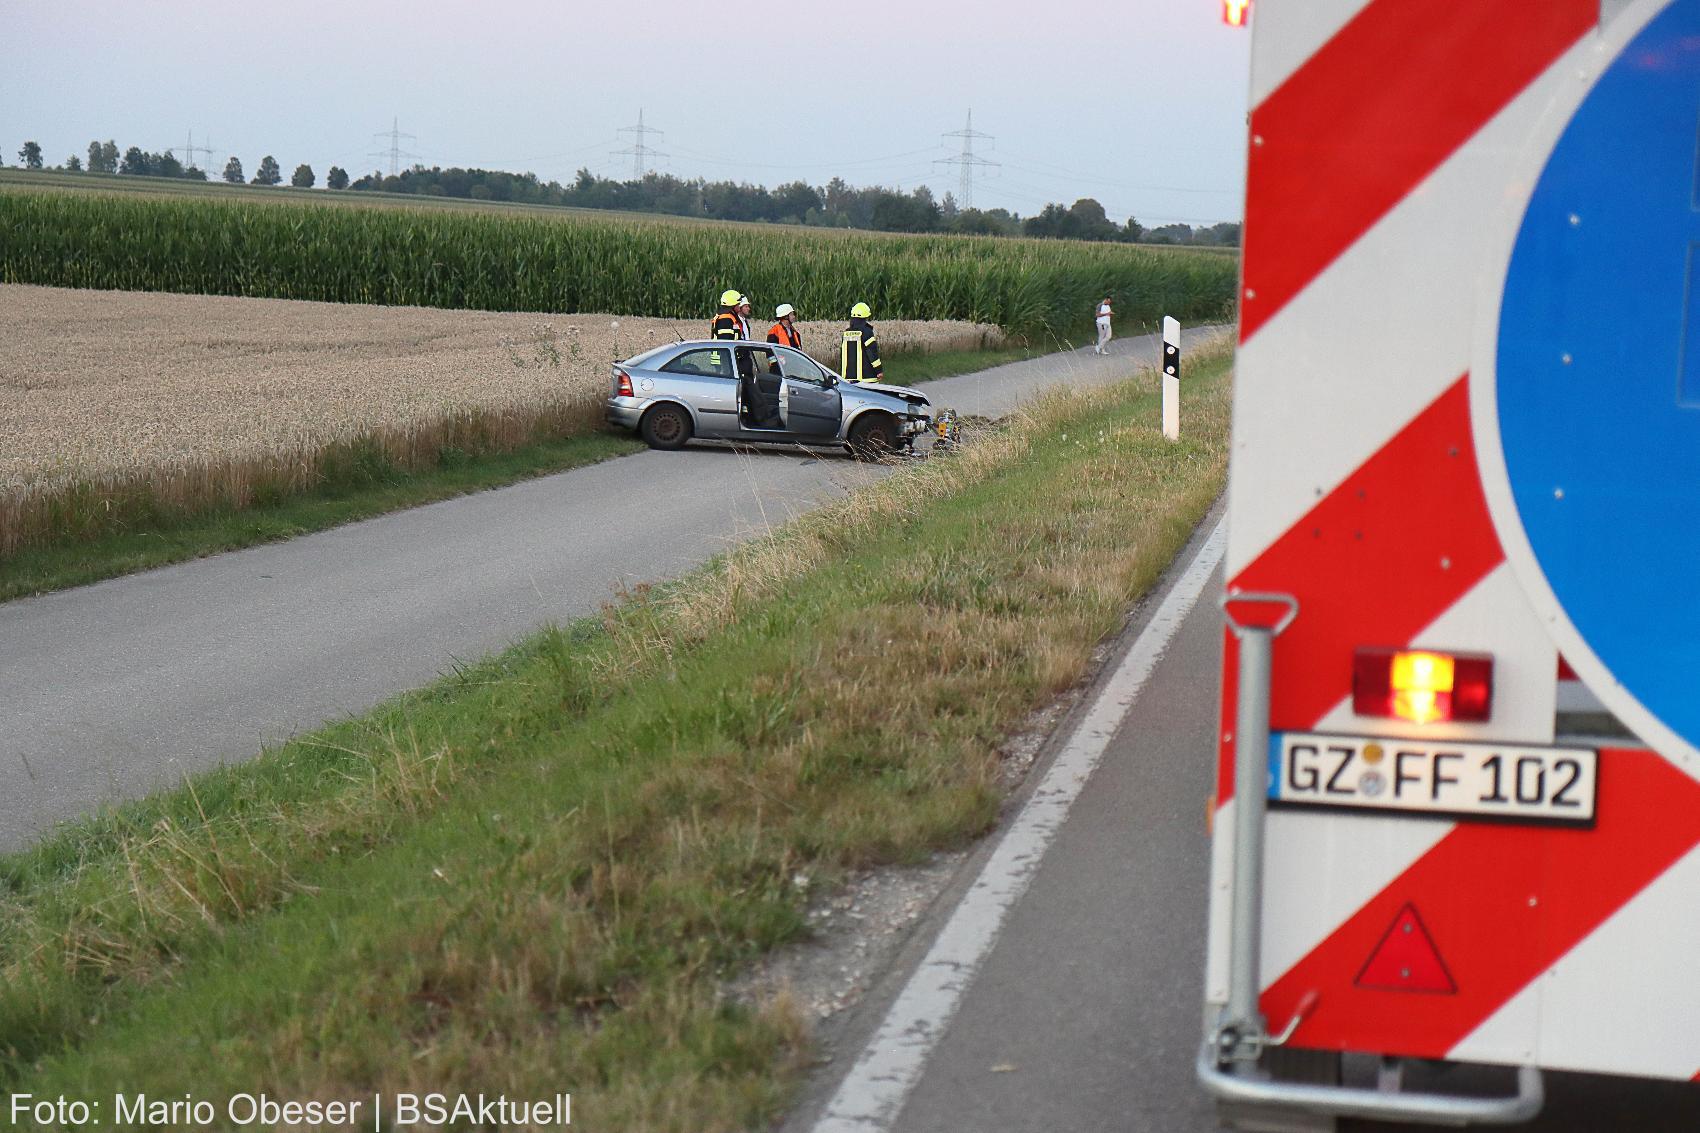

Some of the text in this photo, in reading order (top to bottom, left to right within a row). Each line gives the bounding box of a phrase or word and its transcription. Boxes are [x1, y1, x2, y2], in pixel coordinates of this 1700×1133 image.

[1288, 744, 1582, 807] GZ FF 102
